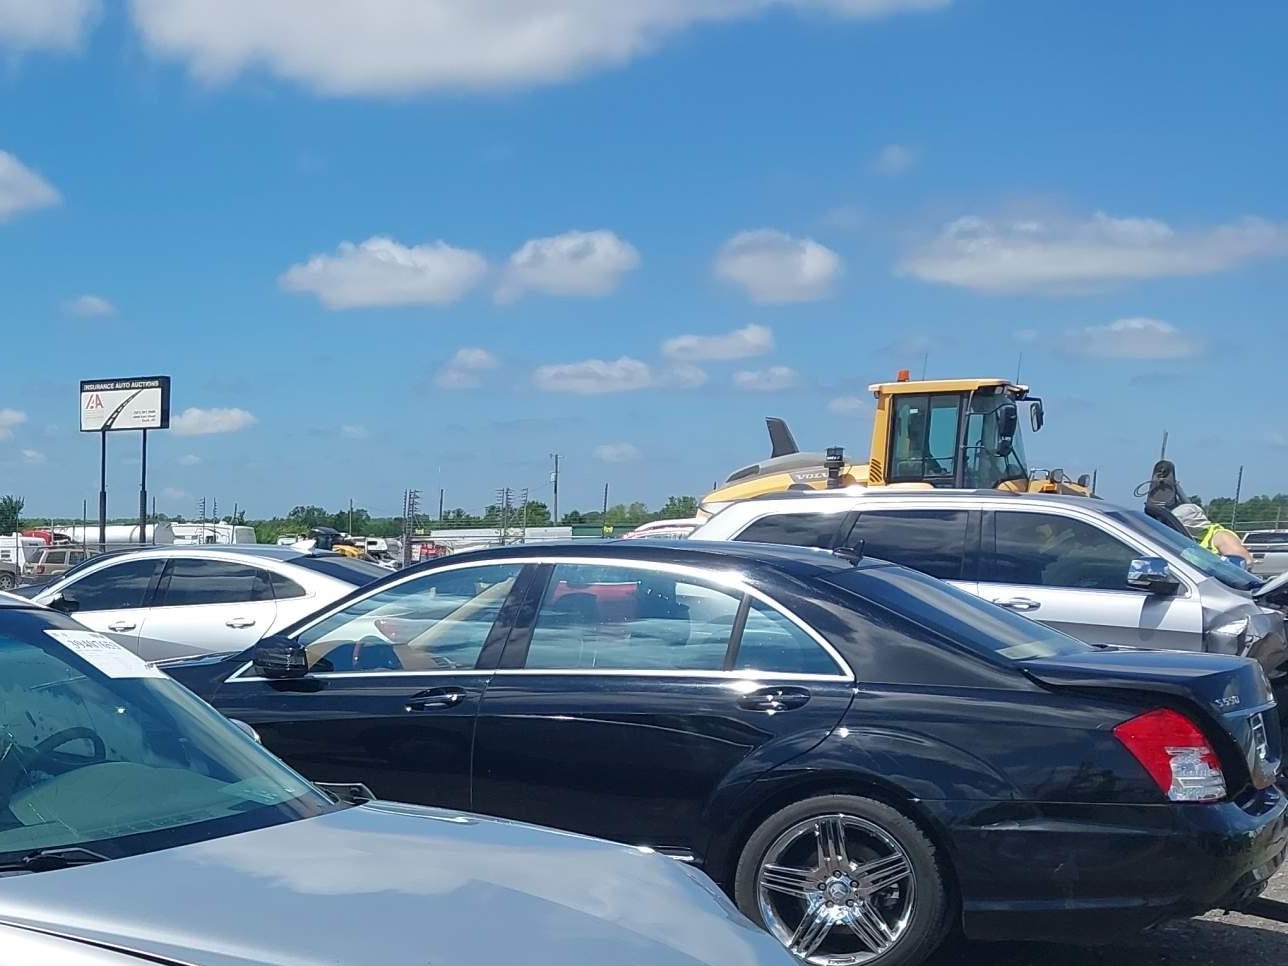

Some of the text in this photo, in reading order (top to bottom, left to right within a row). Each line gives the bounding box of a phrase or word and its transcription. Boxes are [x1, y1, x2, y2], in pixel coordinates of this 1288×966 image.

[83, 379, 160, 391] INSURANCE AUTO AUCTIONS
[795, 472, 830, 480] VOLV
